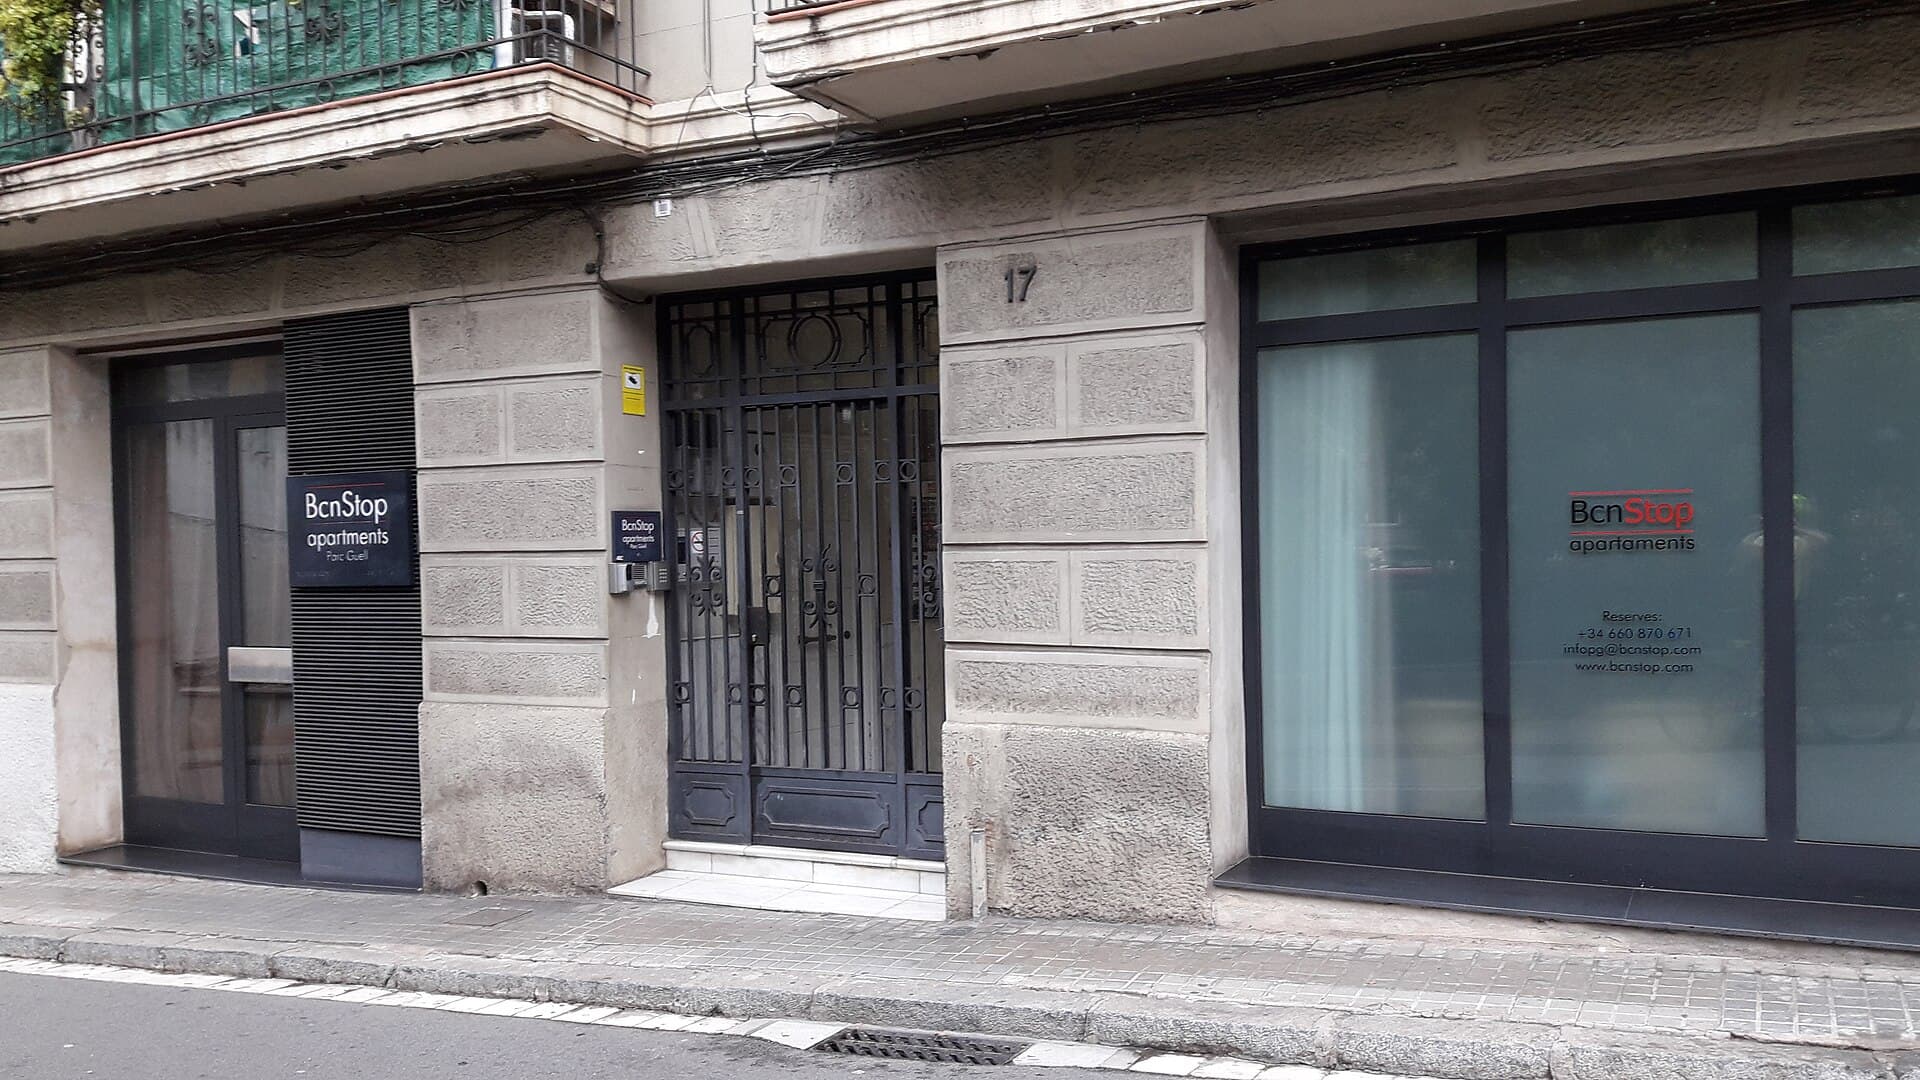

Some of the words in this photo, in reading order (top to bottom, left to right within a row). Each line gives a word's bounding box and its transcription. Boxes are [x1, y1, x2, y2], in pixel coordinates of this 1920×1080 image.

[1004, 265, 1037, 303] 17
[305, 490, 388, 524] BcnStop
[1571, 497, 1695, 528] BcnStop
[622, 519, 655, 534] BcnStop
[307, 528, 389, 552] apartments
[1570, 536, 1695, 555] apartaments
[326, 550, 344, 561] Parc
[1602, 610, 1663, 622] Reserves:
[1577, 628, 1604, 639] +34
[1608, 628, 1634, 639] 660
[1638, 628, 1663, 639] 870
[1667, 627, 1692, 639] 671
[1563, 643, 1702, 657] infopg@bcnstop.com
[1575, 661, 1694, 675] www.bcnstop.com
